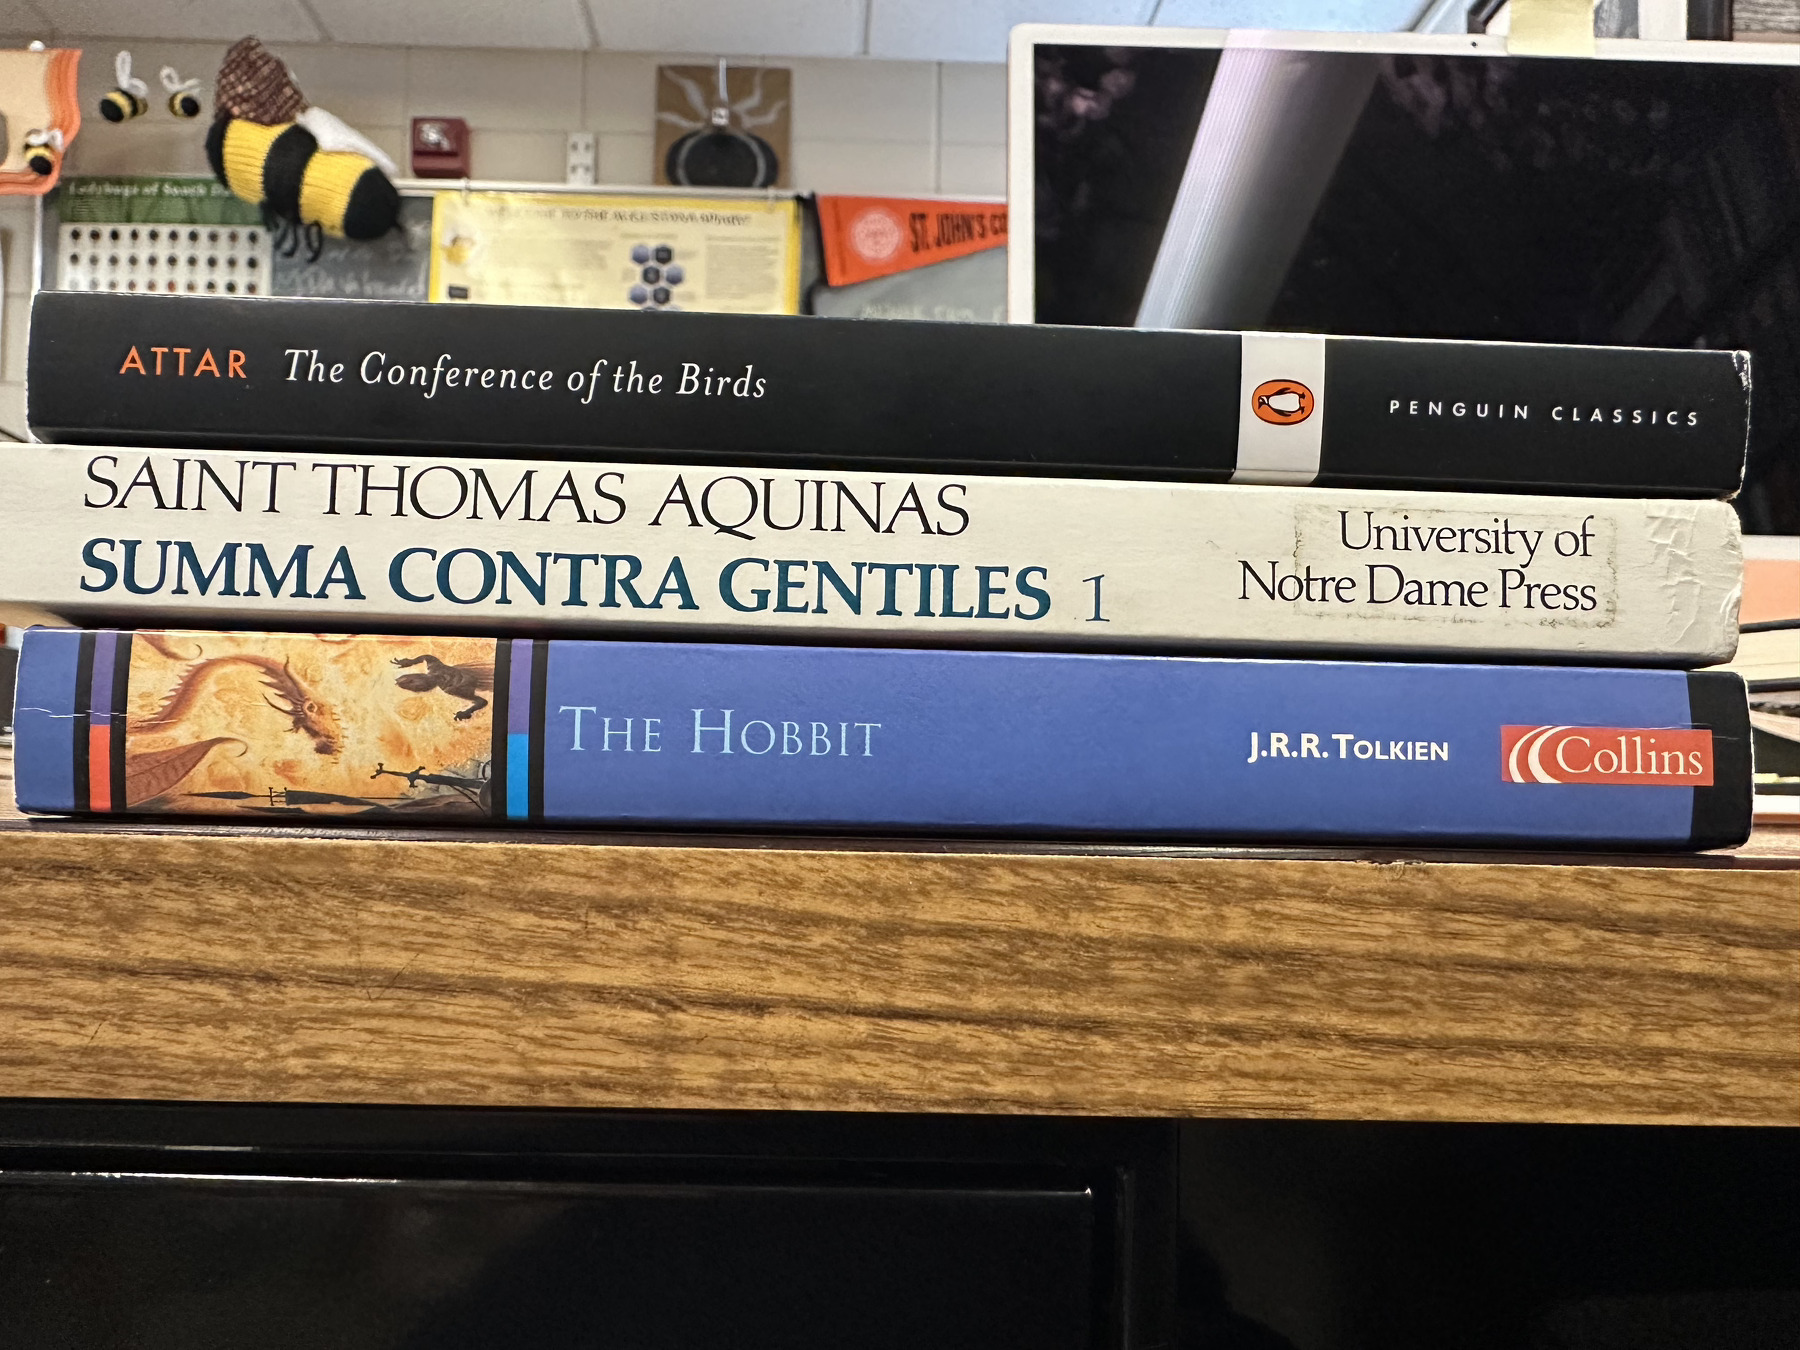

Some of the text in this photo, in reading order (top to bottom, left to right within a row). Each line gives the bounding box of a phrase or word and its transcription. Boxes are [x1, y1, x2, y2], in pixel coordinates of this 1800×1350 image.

[934, 212, 986, 248] JOHN'S
[119, 345, 247, 379] ATTAR
[284, 348, 767, 405] The Conference of the Birds
[1389, 399, 1697, 427] PENGUIN CLASSICS
[84, 455, 970, 541] SAINT THOMAS AQUINAS
[1338, 510, 1596, 569] University of
[79, 537, 1111, 623] SUMMA CONTRA GENTILES 1
[1238, 560, 1597, 611] Notre Dame Press
[558, 705, 882, 757] THE HOBBIT
[1555, 735, 1703, 776] Collins
